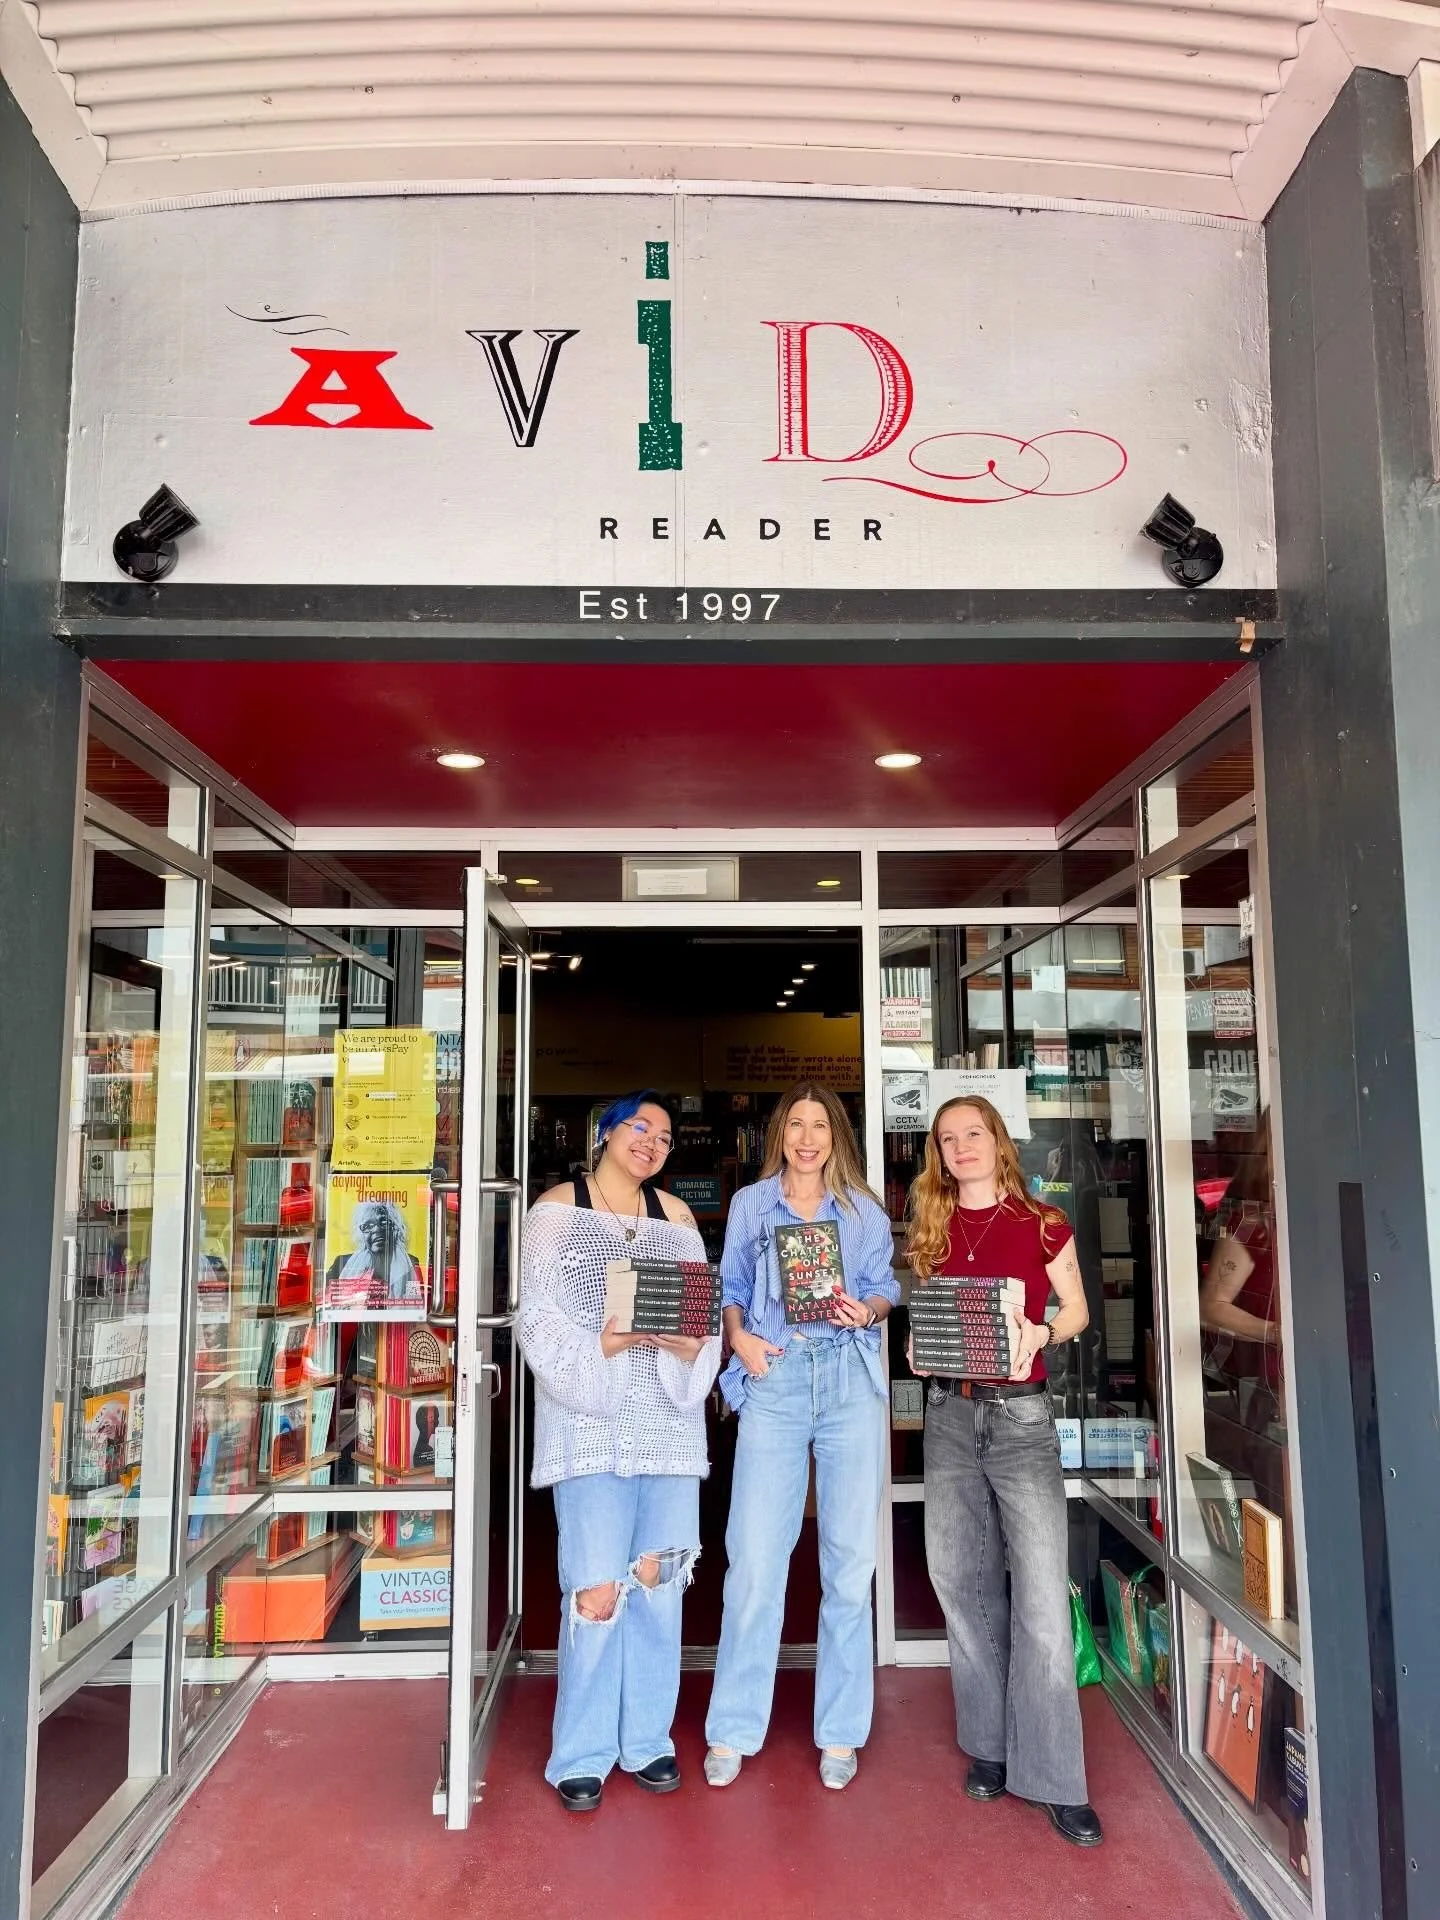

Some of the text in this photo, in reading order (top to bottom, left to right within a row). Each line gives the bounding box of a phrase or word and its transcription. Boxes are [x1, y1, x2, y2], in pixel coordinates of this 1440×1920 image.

[600, 517, 882, 541] READER
[579, 590, 781, 622] Est 1997
[342, 1034, 359, 1043] We
[378, 1033, 408, 1045] proud
[408, 1034, 418, 1043] to
[804, 1055, 834, 1064] wrote
[895, 1116, 919, 1124] CCTV
[332, 1175, 373, 1192] daylight
[676, 1181, 715, 1189] ROMANCE
[357, 1186, 409, 1208] dreaming
[680, 1191, 712, 1199] FICTION
[797, 1234, 821, 1244] THE
[780, 1243, 839, 1258] CHATEAU
[802, 1258, 820, 1267] ON
[788, 1267, 837, 1281] SUNSET
[379, 1588, 451, 1605] CLASSIC
